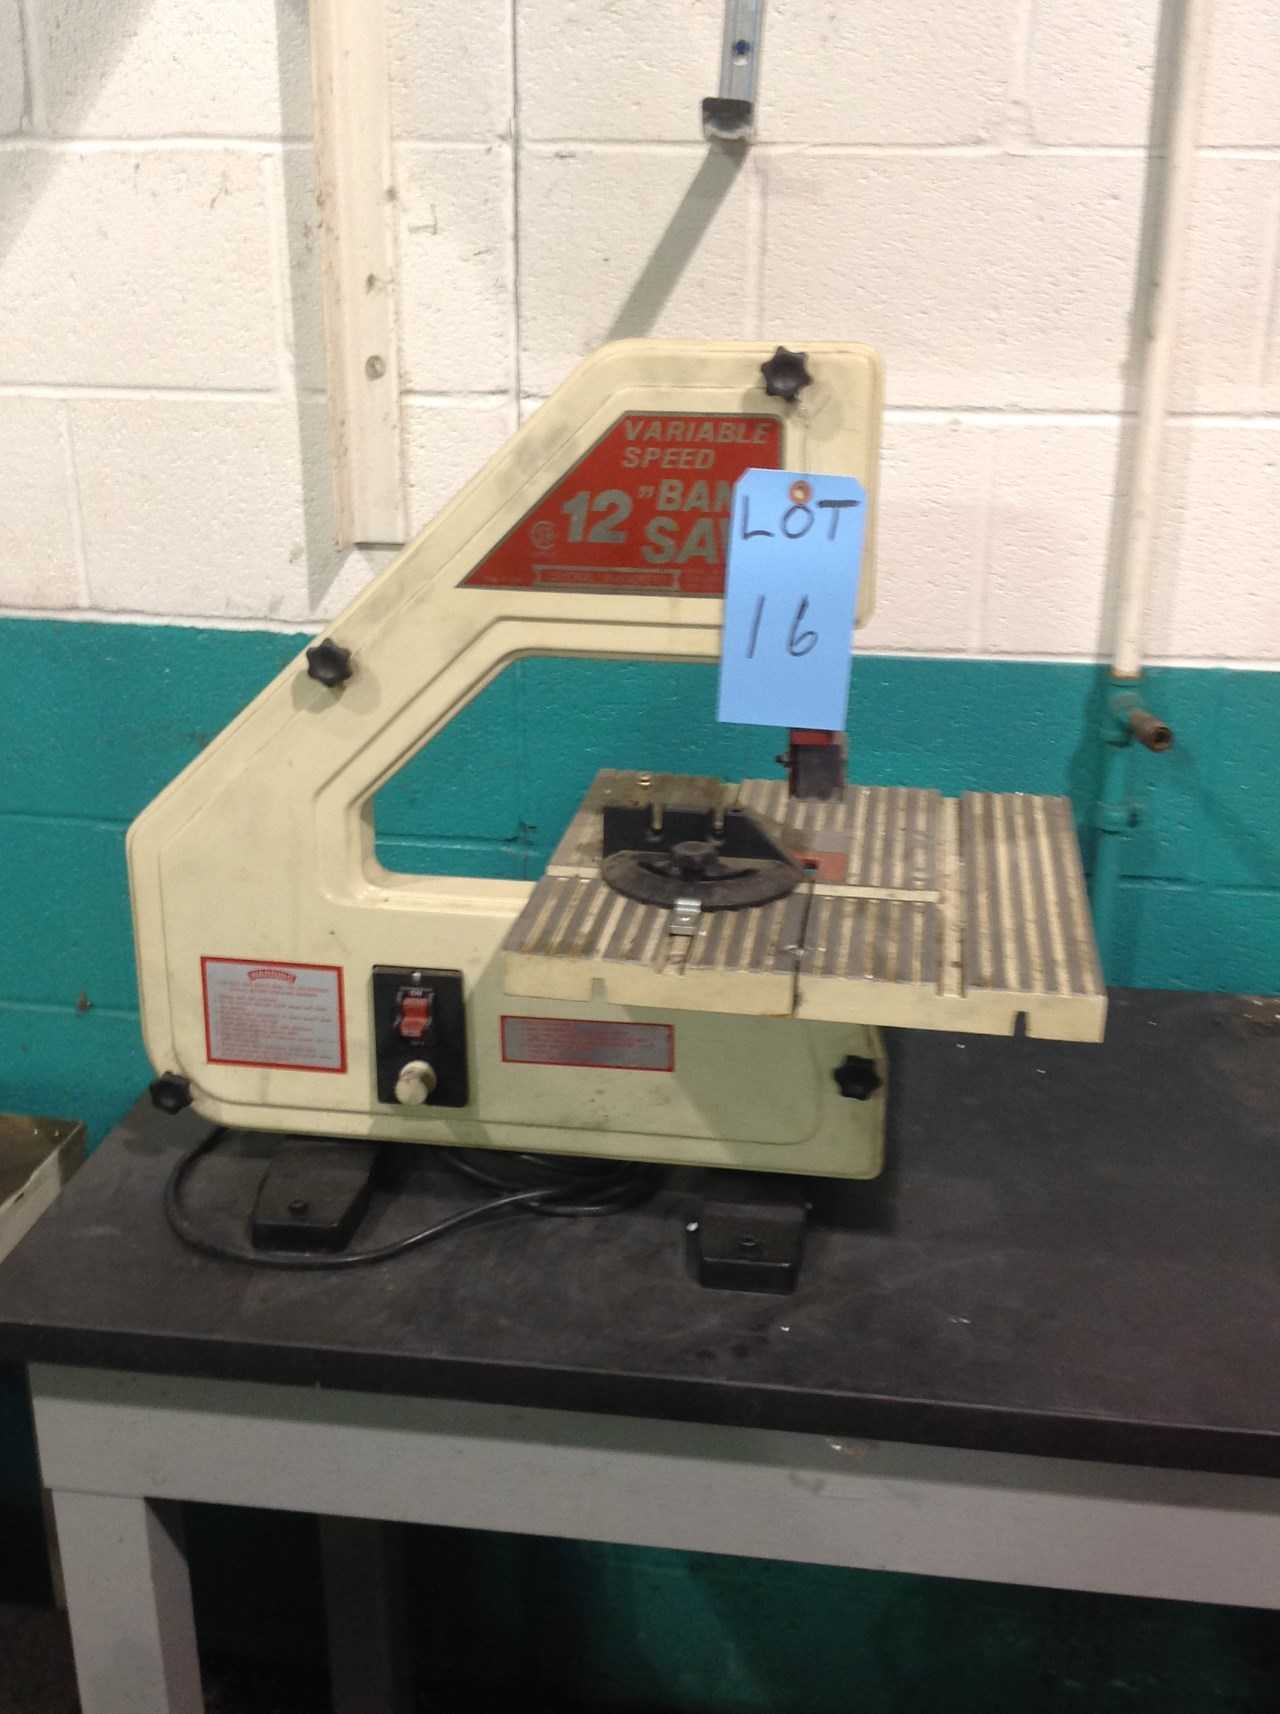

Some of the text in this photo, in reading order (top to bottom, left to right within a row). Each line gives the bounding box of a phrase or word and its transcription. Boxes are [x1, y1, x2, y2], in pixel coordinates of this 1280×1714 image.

[624, 419, 771, 444] VARIABLE
[623, 447, 716, 469] SPEED
[641, 516, 731, 564] SA
[741, 495, 861, 541] LOT
[744, 594, 819, 660] 16
